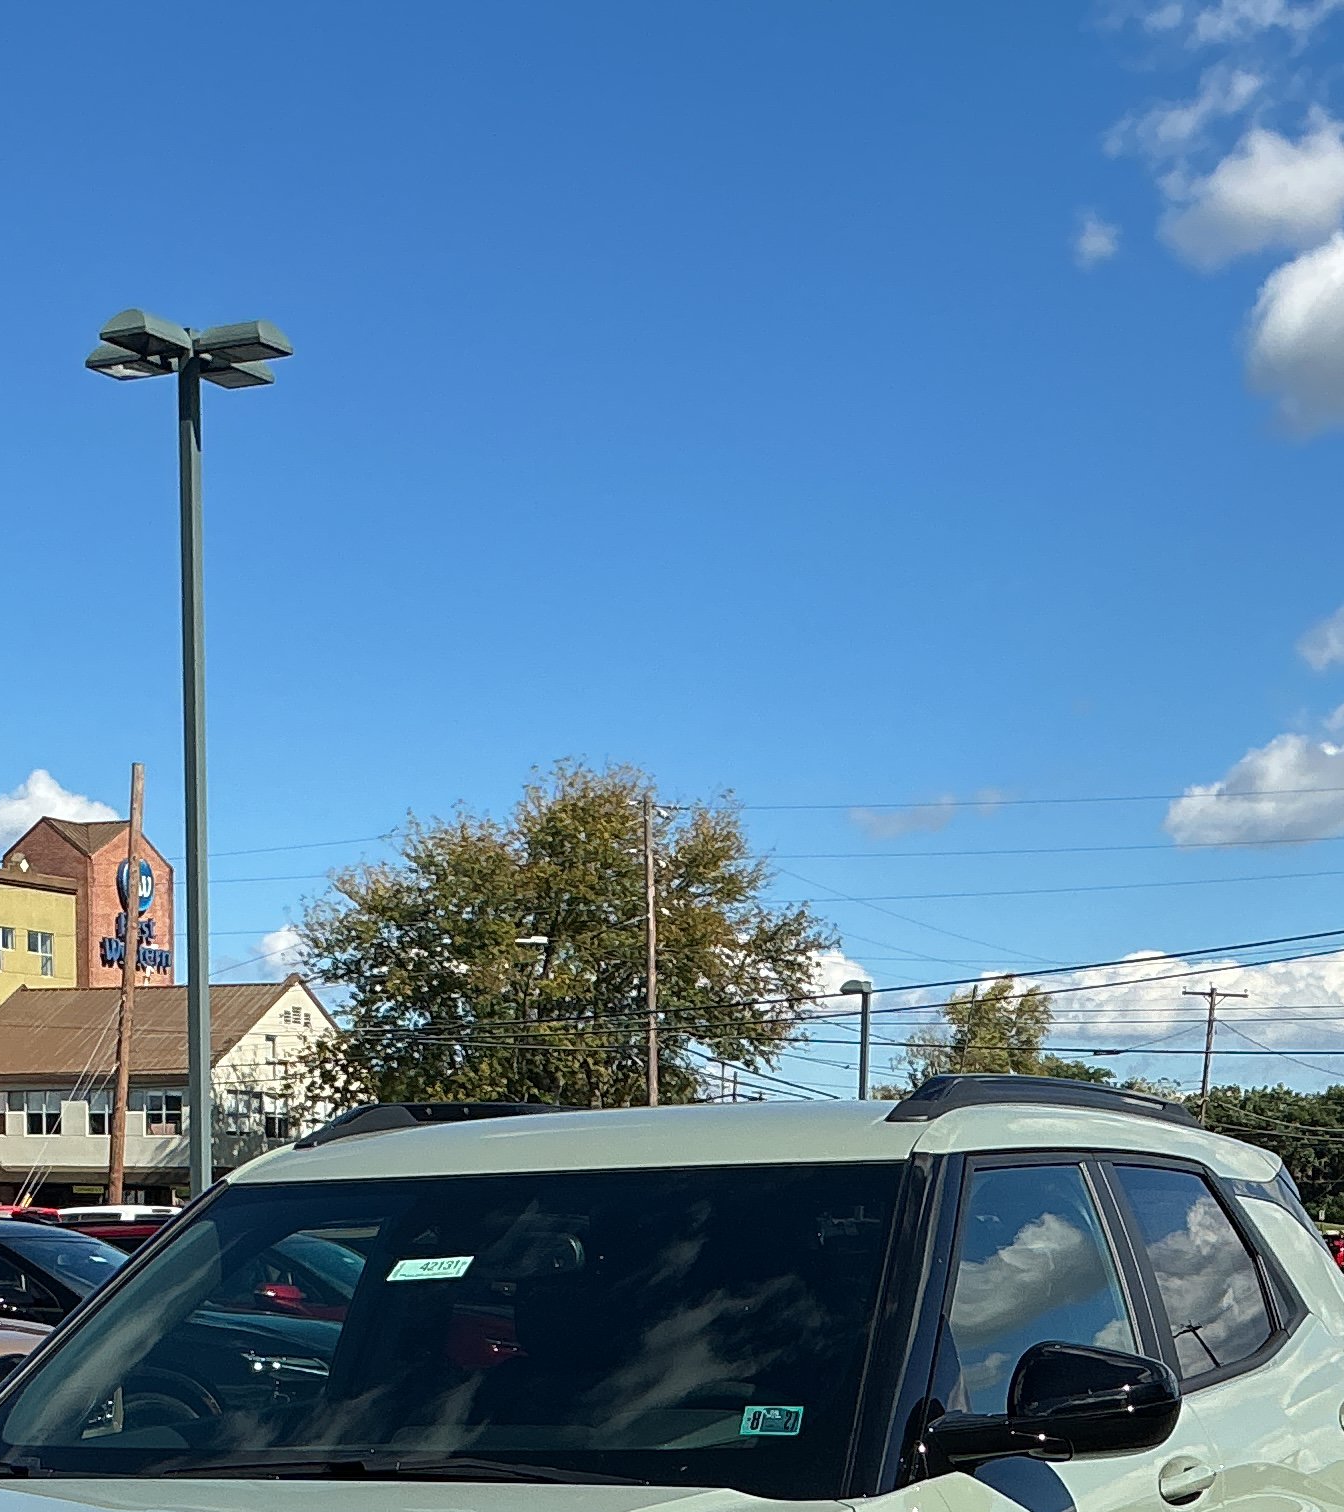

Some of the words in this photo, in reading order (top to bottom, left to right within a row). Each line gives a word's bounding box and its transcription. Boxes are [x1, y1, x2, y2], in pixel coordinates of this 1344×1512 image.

[116, 912, 155, 938] Bst
[102, 937, 171, 968] Wetern
[419, 1260, 460, 1271] 42131
